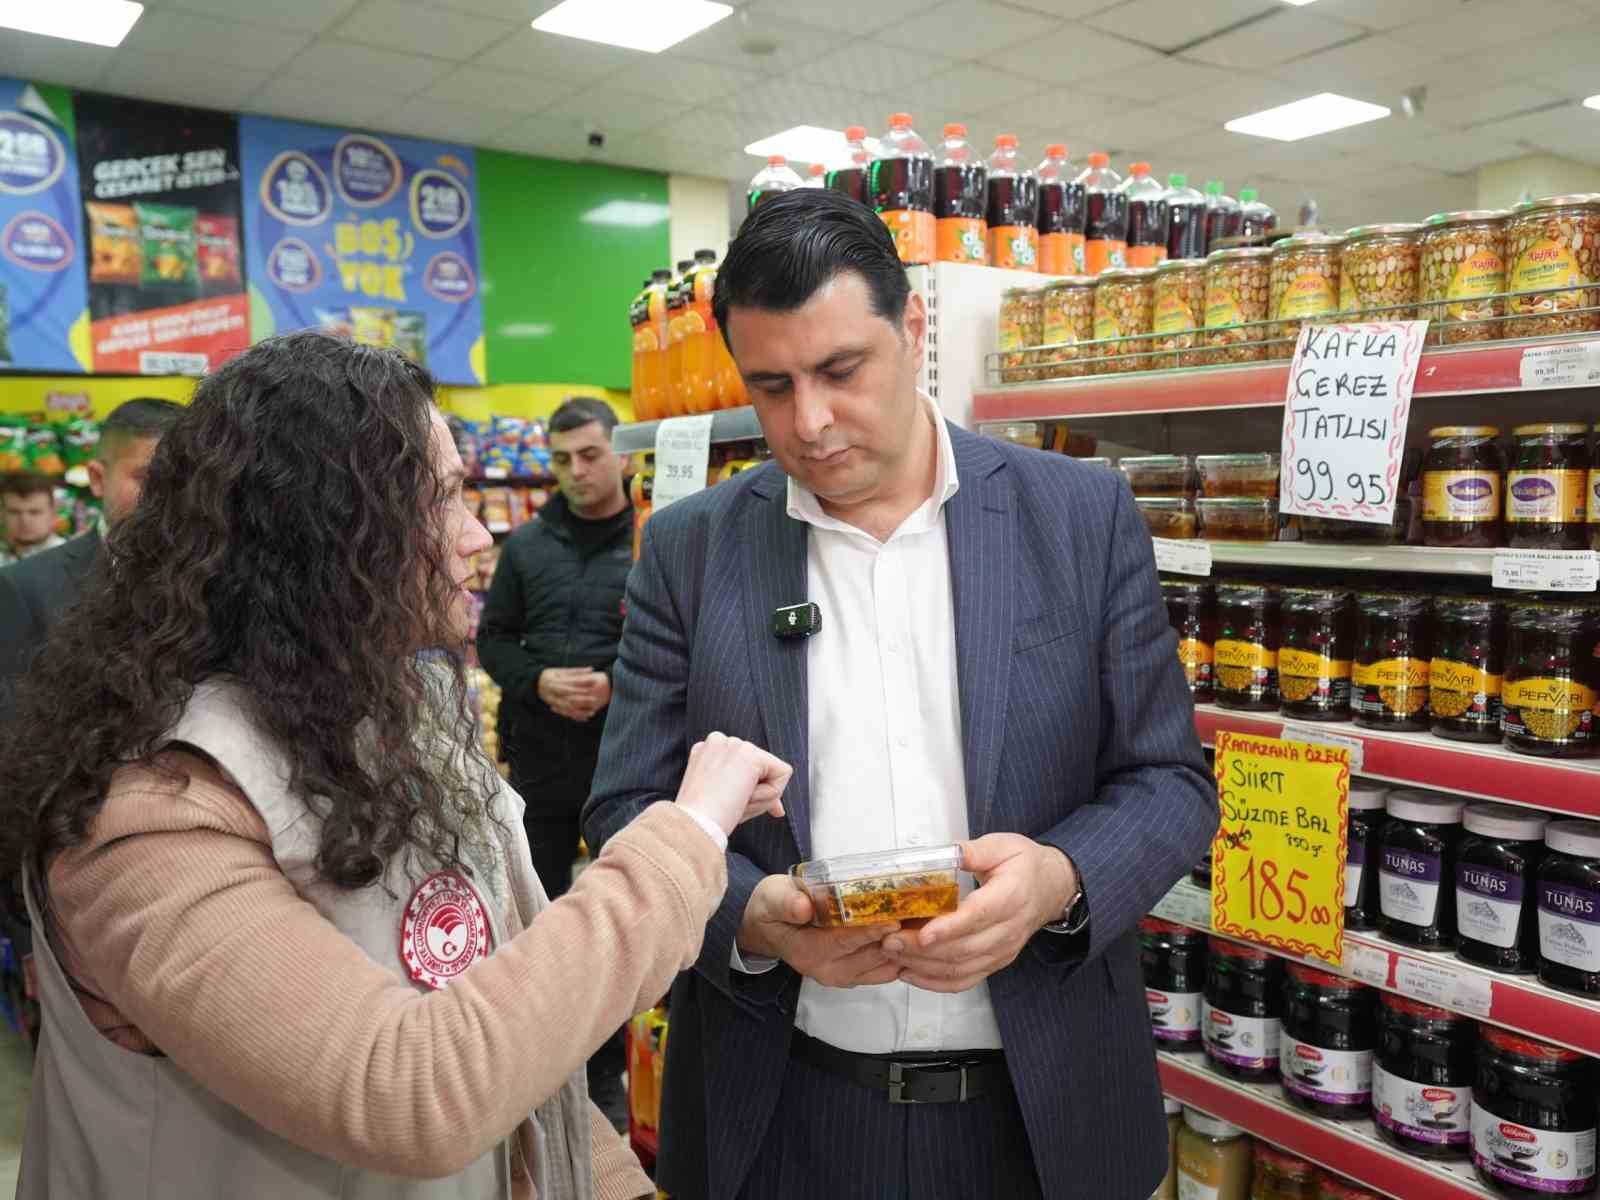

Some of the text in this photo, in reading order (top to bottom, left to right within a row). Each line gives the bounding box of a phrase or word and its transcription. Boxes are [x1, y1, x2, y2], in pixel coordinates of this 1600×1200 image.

[1301, 328, 1396, 359] KAFKA
[1295, 408, 1387, 440] TATLISI
[1296, 807, 1331, 834] BAL
